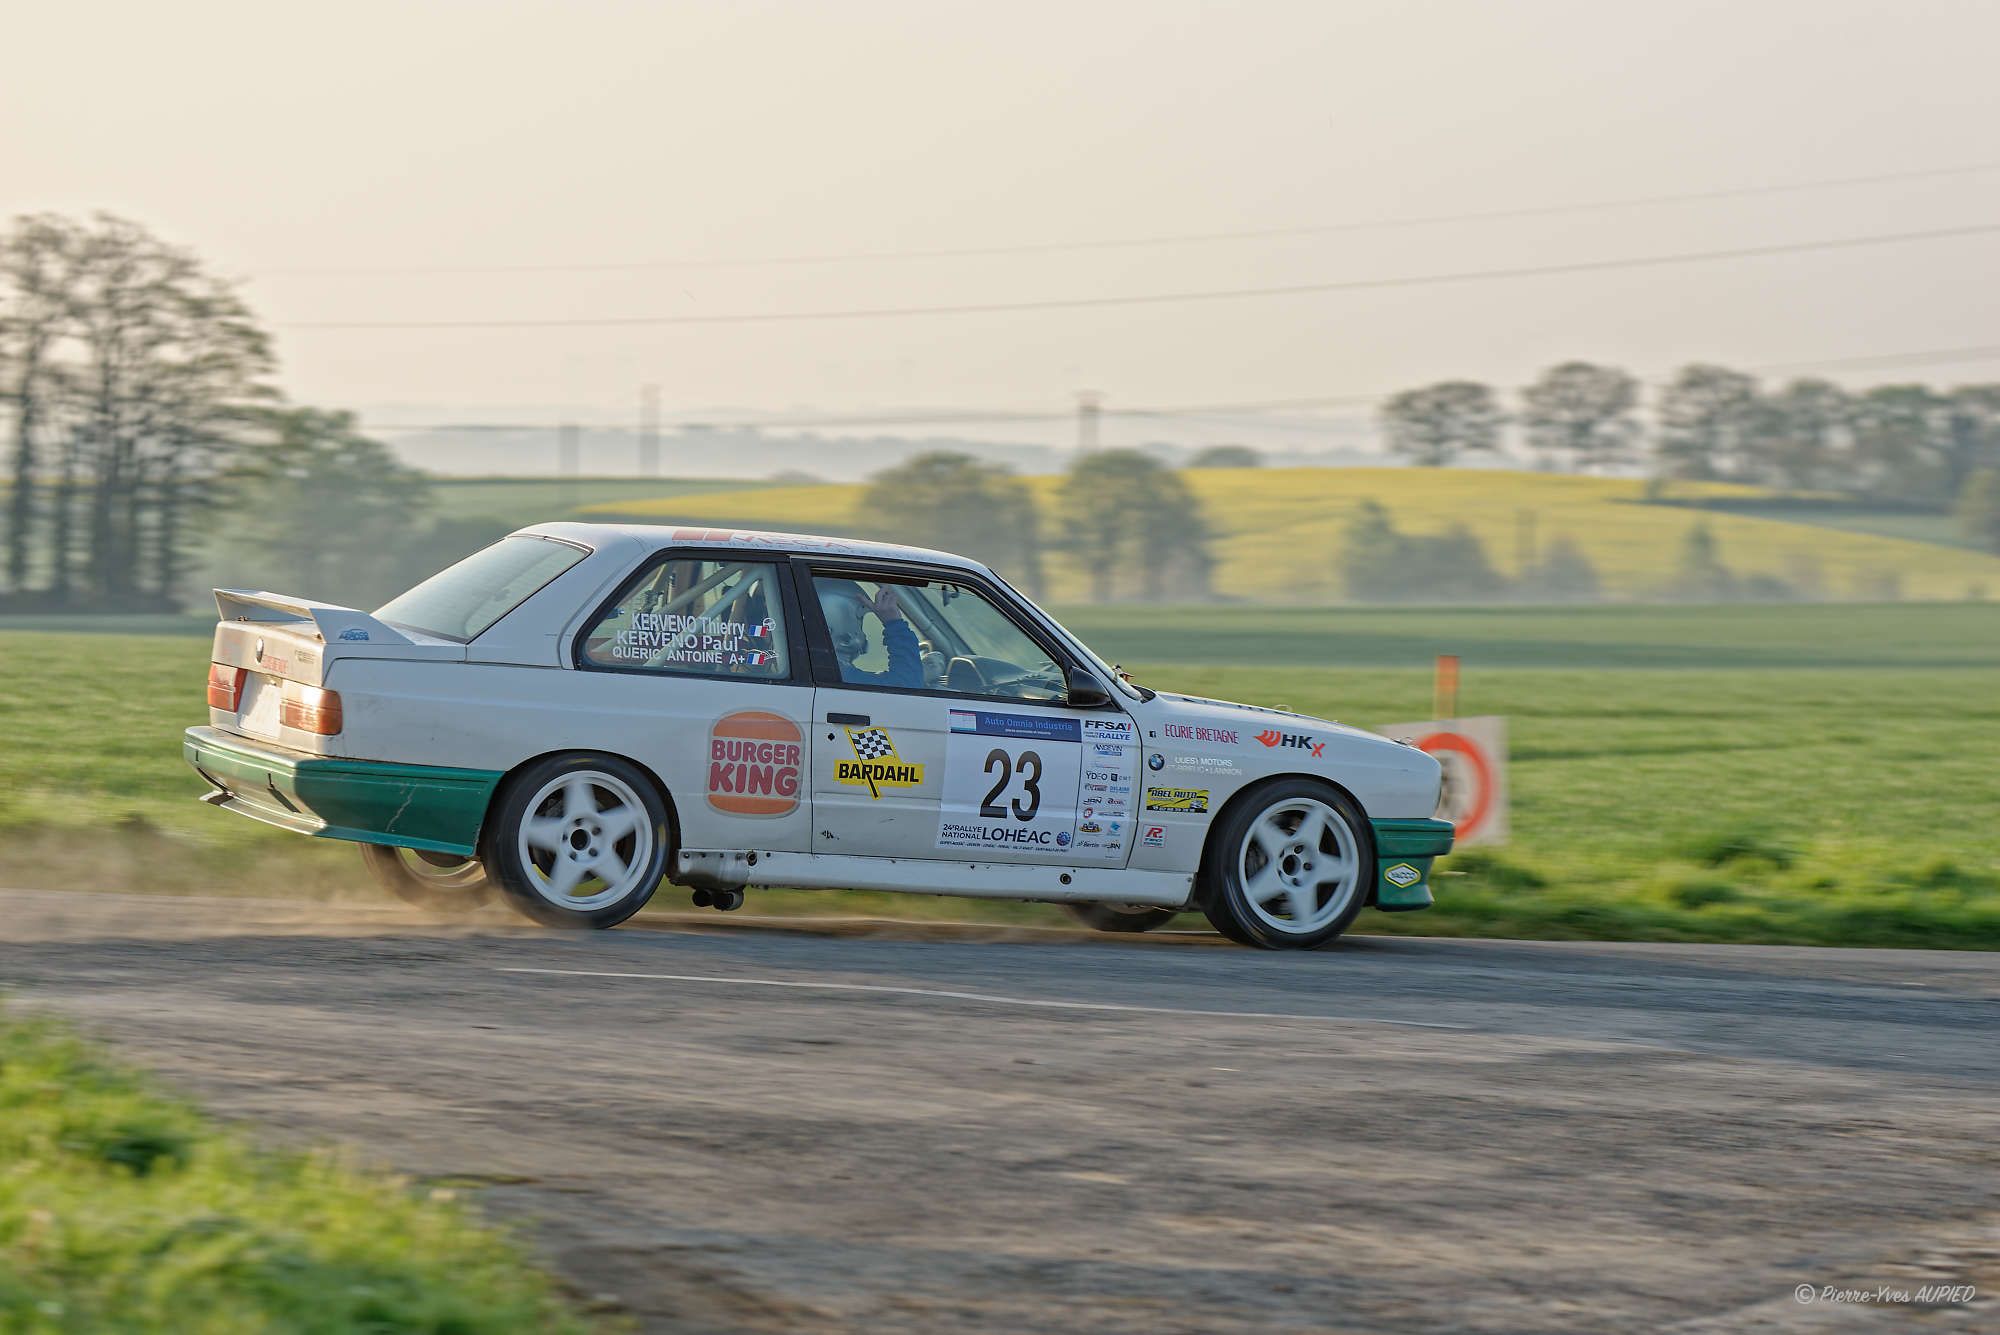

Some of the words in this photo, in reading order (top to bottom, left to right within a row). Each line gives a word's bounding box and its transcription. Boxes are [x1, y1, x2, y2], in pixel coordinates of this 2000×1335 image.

[632, 613, 697, 633] KERVENO
[699, 616, 745, 639] Thierry
[616, 630, 698, 648] KERVENO
[702, 635, 738, 652] Paul
[667, 651, 723, 664] ANTOINE
[984, 717, 1005, 727] Auto
[1006, 719, 1033, 729] Omnia
[1085, 720, 1129, 731] FFSA
[1098, 732, 1131, 741] RALLYE
[1165, 724, 1193, 739] ECURIE
[1196, 727, 1239, 744] BRETAGNE
[711, 739, 800, 766] BURGER
[709, 761, 798, 796] KING
[838, 763, 919, 783] BARDAHL
[979, 748, 1042, 822] 23
[941, 831, 981, 841] NATIONAL
[982, 827, 1052, 845] LOHÉAC
